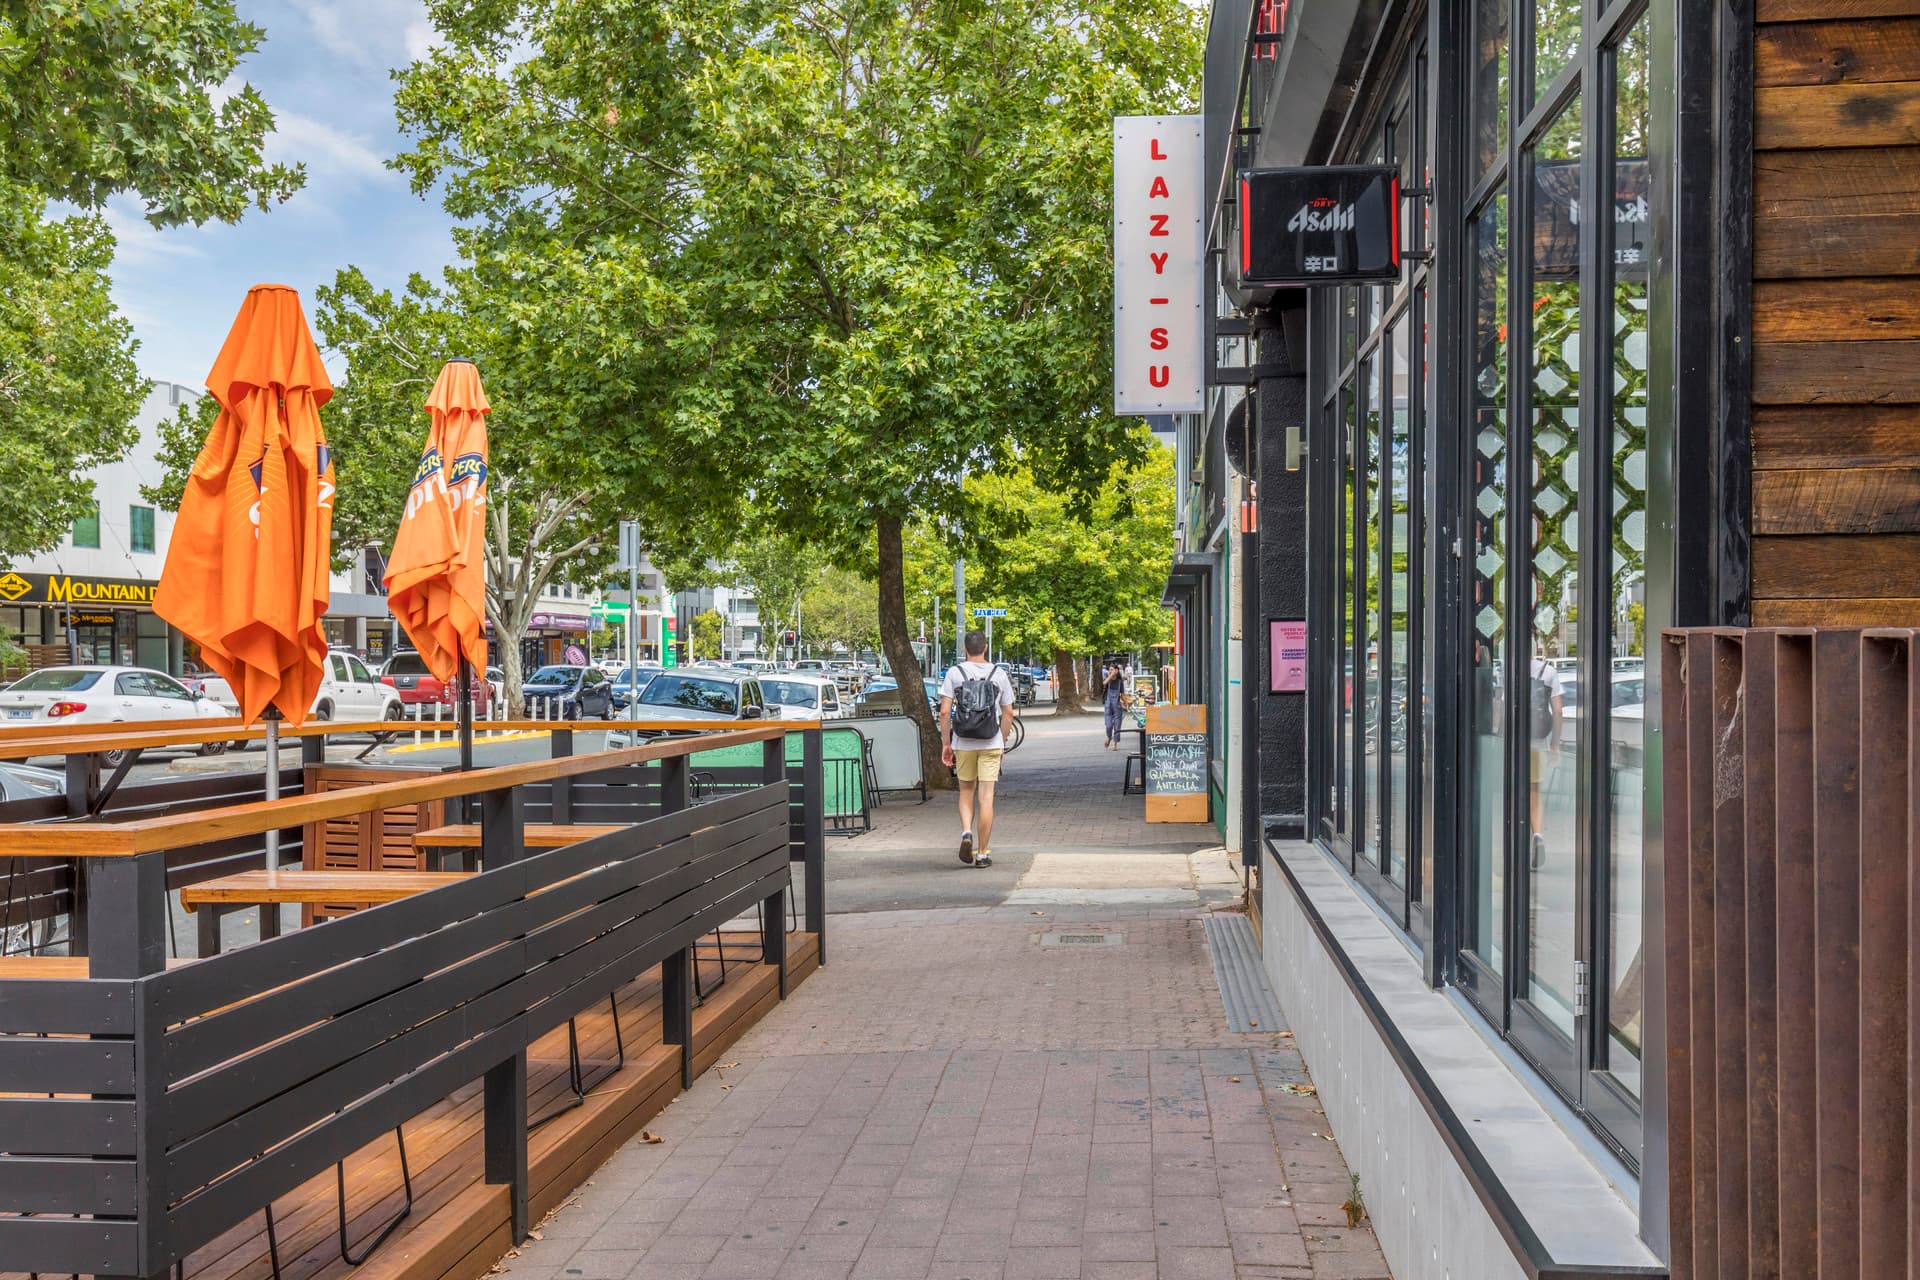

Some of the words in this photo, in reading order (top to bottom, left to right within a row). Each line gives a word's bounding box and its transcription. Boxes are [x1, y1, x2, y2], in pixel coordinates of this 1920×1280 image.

[1287, 203, 1355, 232] Asahi
[1304, 256, 1338, 272] 辛口
[1150, 733, 1176, 743] HOUSE
[1178, 734, 1205, 742] BLEND
